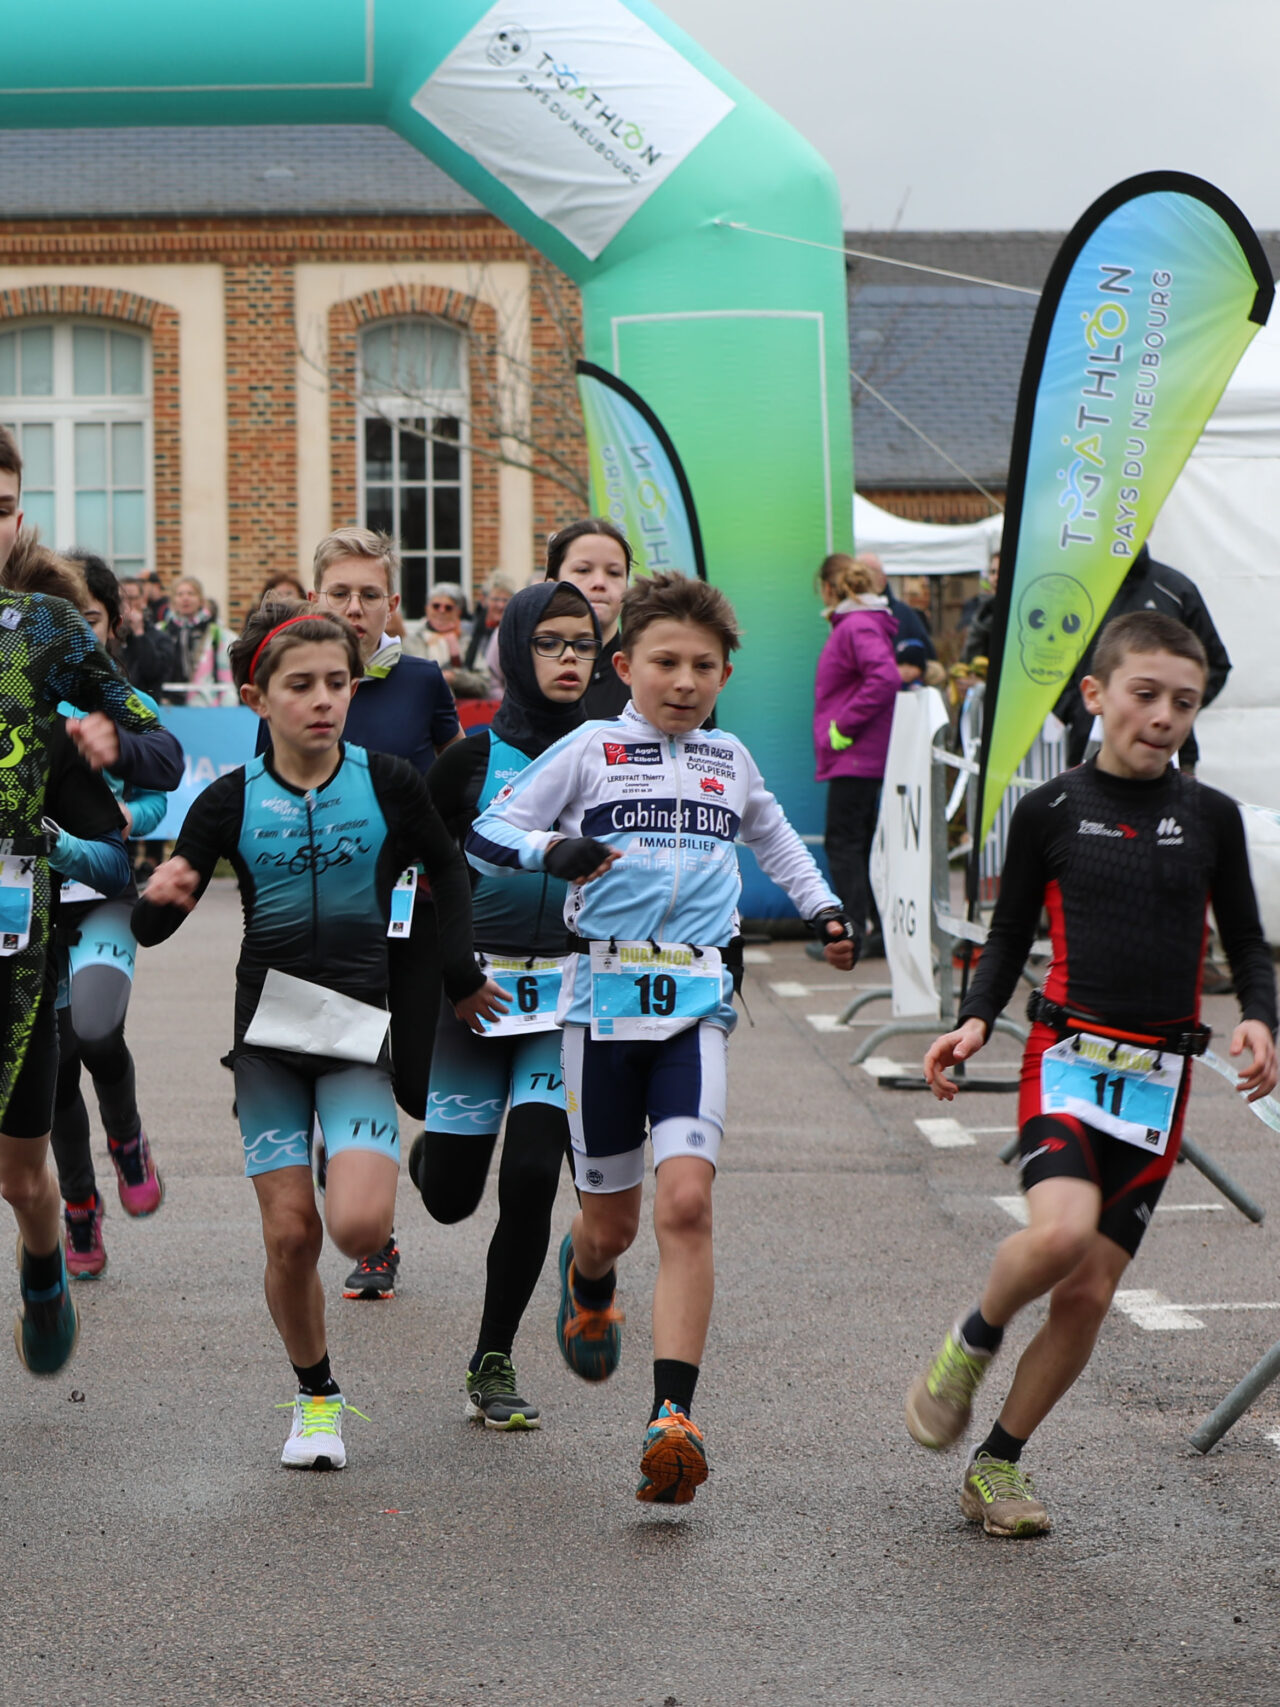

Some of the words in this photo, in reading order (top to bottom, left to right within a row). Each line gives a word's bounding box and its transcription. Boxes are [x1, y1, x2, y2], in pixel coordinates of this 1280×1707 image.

[518, 74, 548, 104] PAYS
[549, 102, 570, 122] DU
[571, 118, 642, 184] NEUBOURG
[1132, 270, 1172, 429] NEUBOURG
[1124, 438, 1146, 478] DU
[1112, 487, 1140, 556] PAYS
[641, 774, 665, 782] Thierry
[611, 802, 691, 830] Cabinet
[696, 806, 732, 837] BIAS
[517, 975, 538, 1013] 6
[634, 974, 677, 1016] 19
[529, 1072, 565, 1091] TV
[1090, 1072, 1126, 1117] 11
